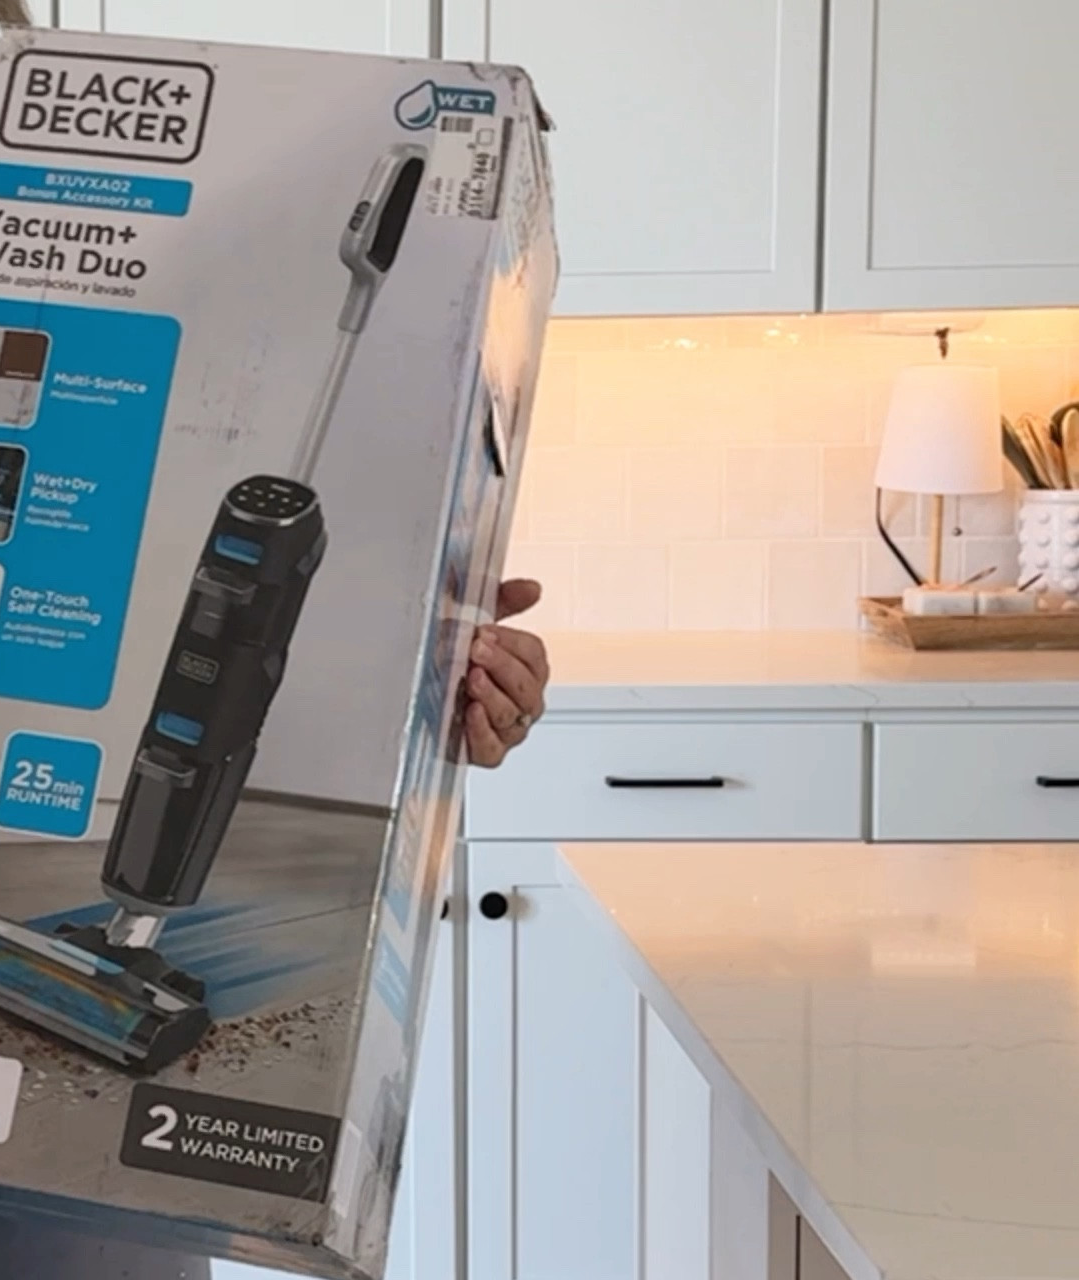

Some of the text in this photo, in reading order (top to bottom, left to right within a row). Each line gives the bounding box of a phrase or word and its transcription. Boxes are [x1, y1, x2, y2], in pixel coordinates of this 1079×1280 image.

[25, 68, 192, 108] BLACK+
[437, 92, 492, 110] WET
[18, 102, 188, 145] DECKER
[17, 185, 153, 209] Bonus Accessory Kit
[78, 249, 147, 281] Duo
[13, 275, 79, 293] aspiración
[93, 283, 137, 299] lavado
[53, 372, 148, 394] Multi-Surface
[30, 486, 78, 505] Pickup
[34, 472, 97, 494] Wet+Dry
[10, 586, 90, 607] One-Touch
[7, 600, 101, 626] Self Cleaning
[11, 760, 84, 796] 25 min
[5, 787, 83, 812] RUNTIME
[140, 1104, 179, 1151] 2
[184, 1112, 325, 1153] YEAR LIMITED
[180, 1137, 301, 1173] WARRANTY
